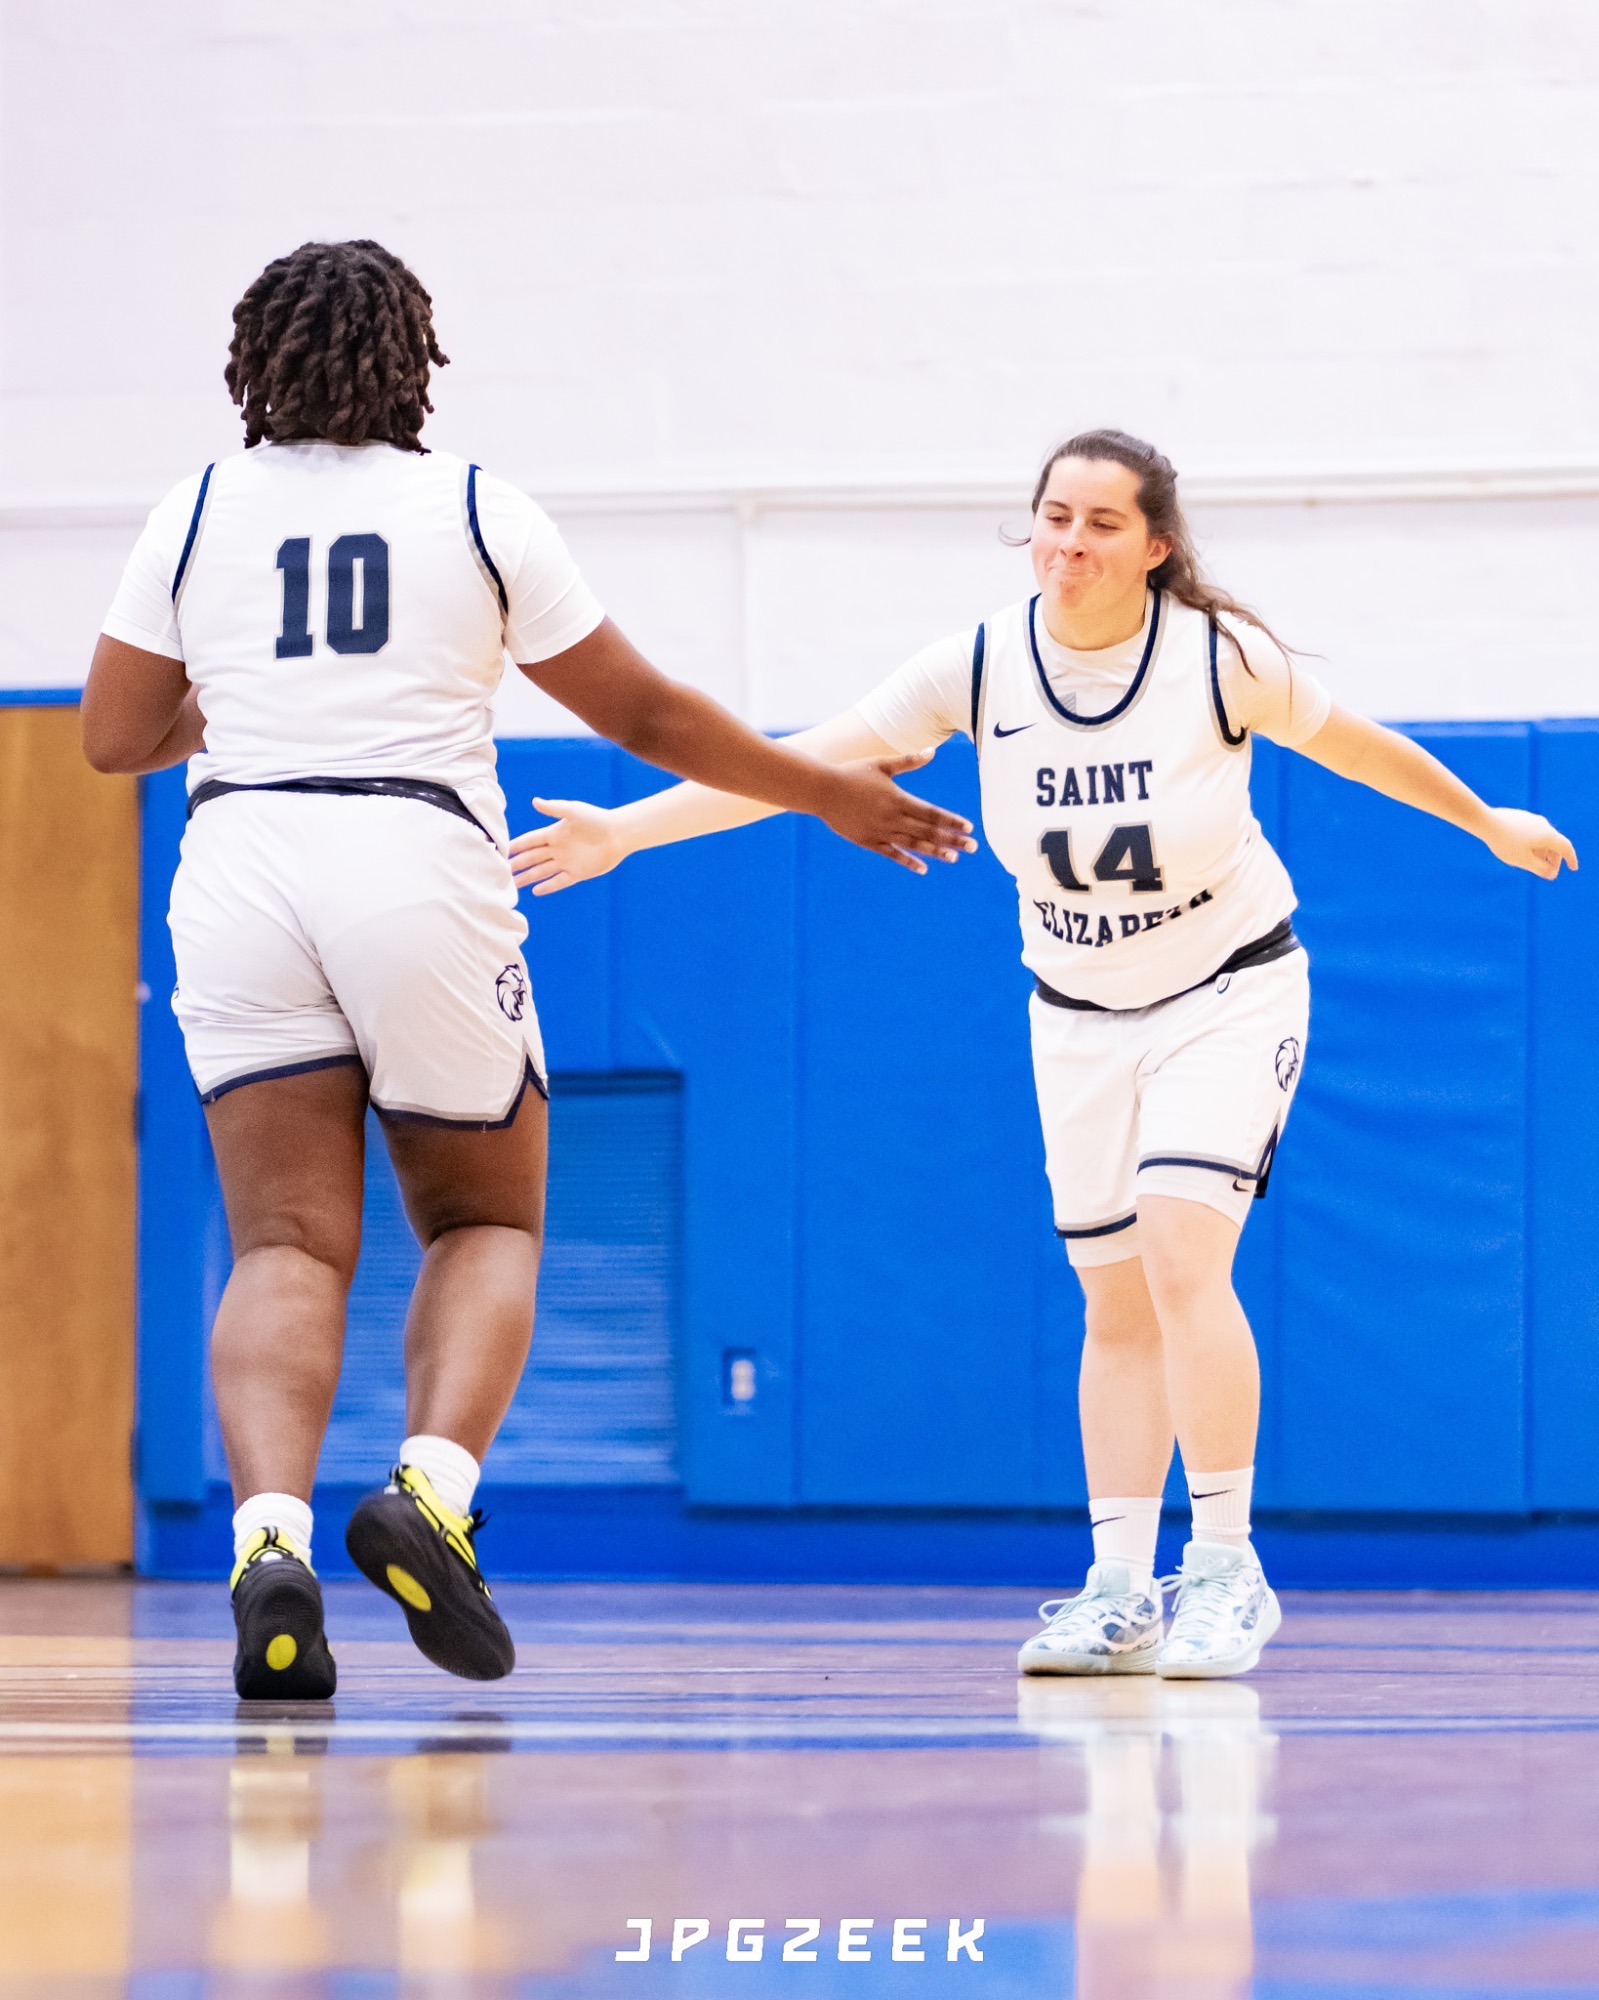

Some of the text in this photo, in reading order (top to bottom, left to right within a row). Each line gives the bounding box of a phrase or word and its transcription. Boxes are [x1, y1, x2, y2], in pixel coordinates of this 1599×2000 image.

[273, 530, 391, 662] 10
[1036, 759, 1153, 807] SAINT
[1037, 820, 1166, 895] 14
